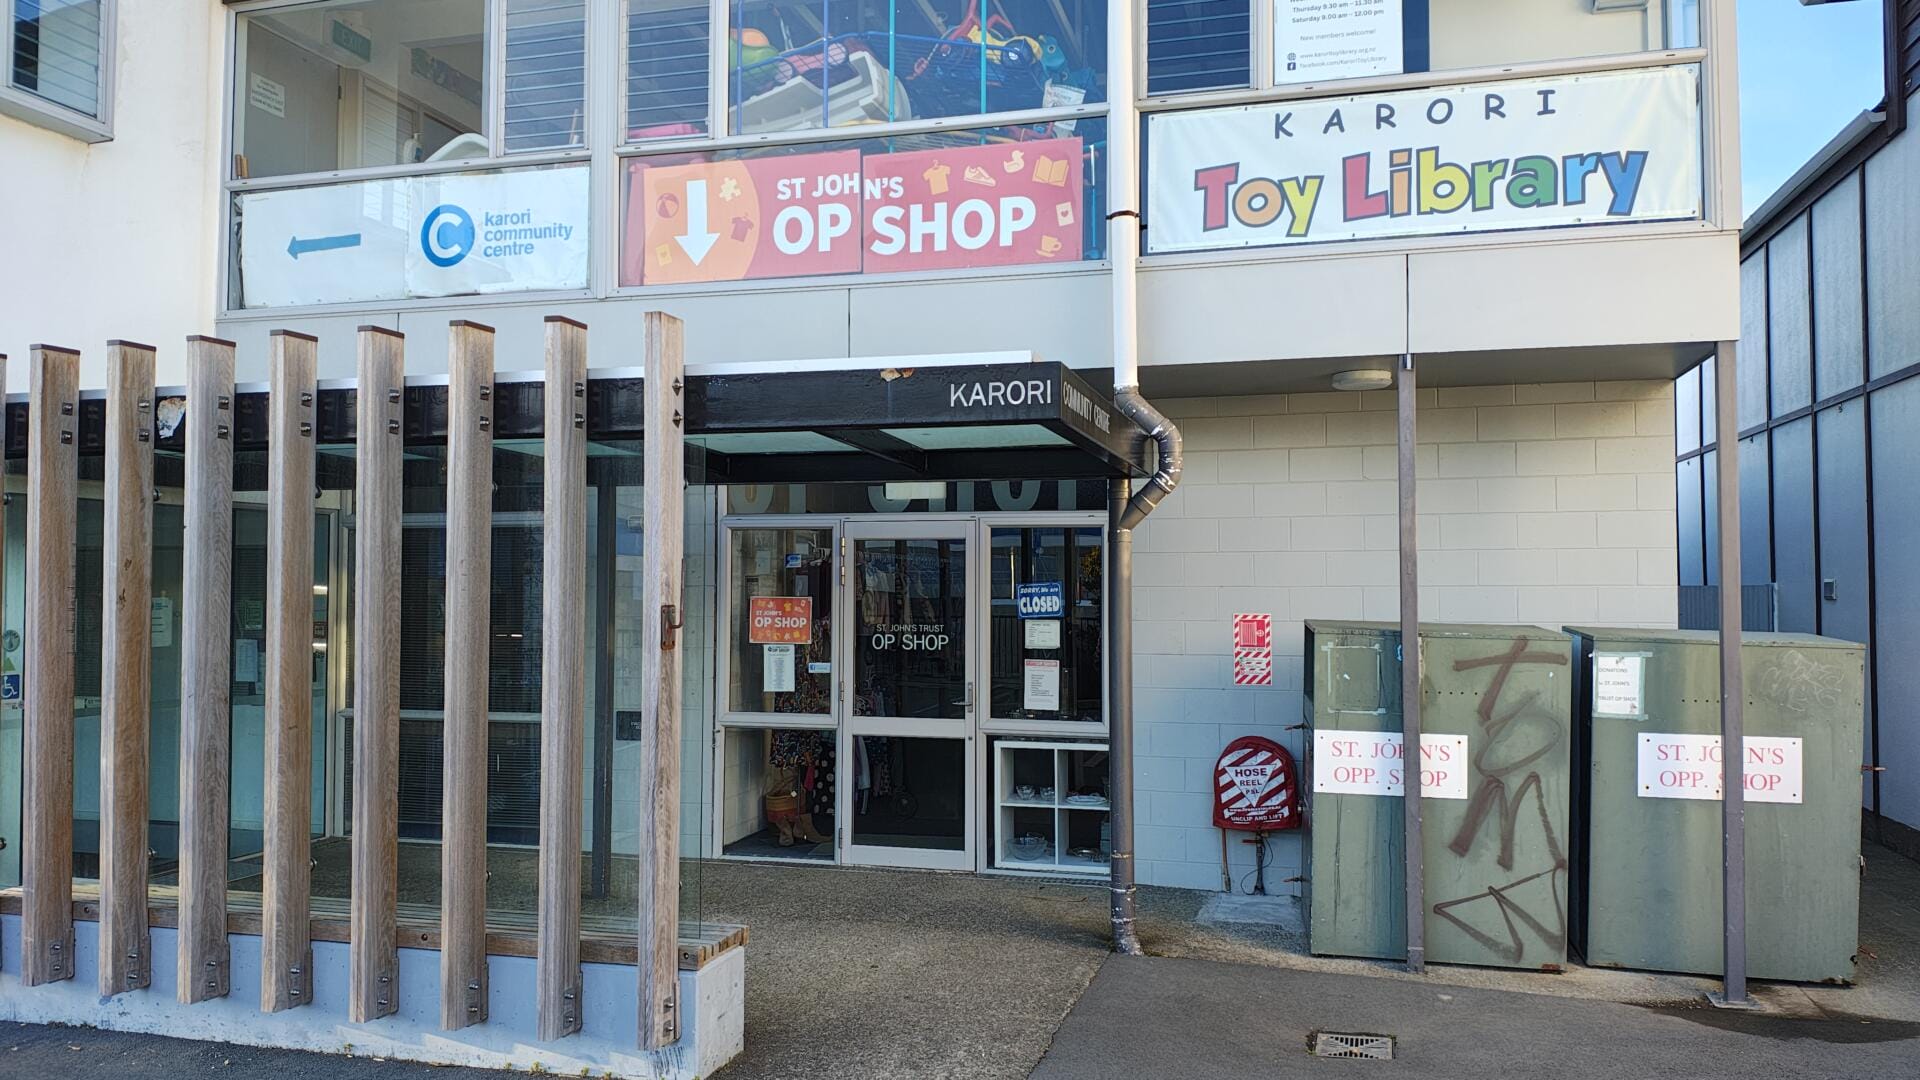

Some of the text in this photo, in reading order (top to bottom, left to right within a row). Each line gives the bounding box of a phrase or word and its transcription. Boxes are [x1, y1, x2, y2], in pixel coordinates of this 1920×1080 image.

[1274, 89, 1556, 139] KARORI
[777, 178, 805, 200] ST
[1194, 146, 1649, 238] Toy Library
[484, 209, 531, 227] karori
[773, 196, 1036, 256] OP SHOP
[484, 223, 573, 242] community
[483, 241, 535, 258] centre
[950, 379, 1052, 407] KARORI
[1020, 595, 1060, 614] CLOSED
[755, 617, 807, 628] OP SHOP
[890, 624, 917, 632] JOHN'S
[919, 624, 944, 633] TRUST
[872, 633, 949, 651] OP SHOP
[1331, 740, 1362, 758] ST.
[1657, 744, 1784, 765] ST. JON'S
[1235, 767, 1268, 777] HOSE
[1334, 766, 1448, 787] OPP. SOP
[1659, 770, 1708, 788] OPP.
